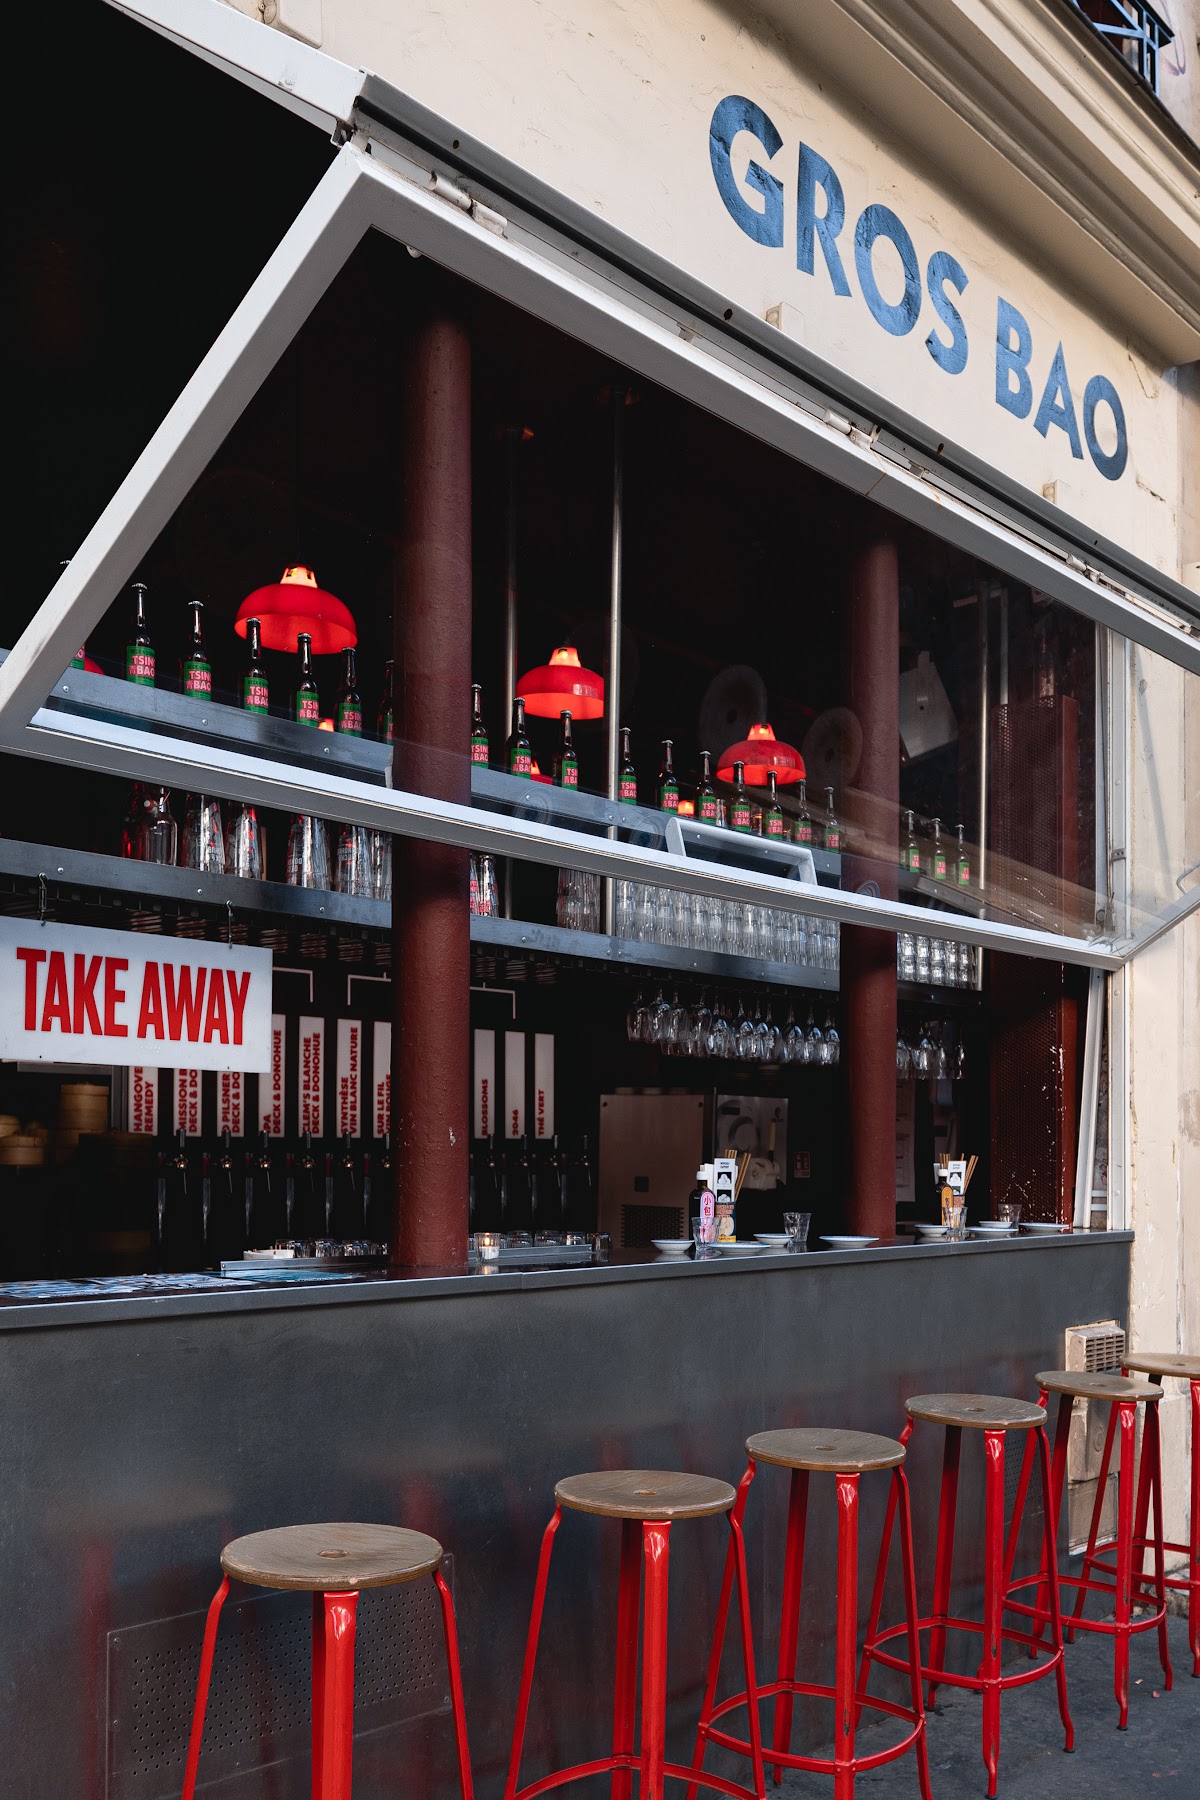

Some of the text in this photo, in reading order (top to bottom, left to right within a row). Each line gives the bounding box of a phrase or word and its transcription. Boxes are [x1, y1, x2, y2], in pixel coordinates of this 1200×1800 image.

[709, 94, 1128, 481] GROS BAO
[132, 655, 155, 668] TSIN
[189, 670, 212, 682] TSIN
[472, 745, 488, 754] TSIN
[16, 946, 252, 1045] TAKE AWAY
[303, 1036, 312, 1090] BLANCHE
[350, 1027, 358, 1072] NATURE
[134, 1066, 143, 1132] HANGOVE
[144, 1081, 154, 1132] REMEDY
[178, 1068, 188, 1130] MISSION B
[188, 1069, 198, 1133] DECK & DO
[222, 1073, 230, 1121] PILSNER
[232, 1072, 240, 1133] DECK & DO
[272, 1030, 282, 1134] DECK & DONOHUE
[312, 1032, 320, 1134] DECK & DONOHUE
[340, 1076, 348, 1134] SYNTHÈSE
[350, 1074, 358, 1112] BLANC
[377, 1099, 384, 1112] LE
[704, 1194, 712, 1216] 小包
